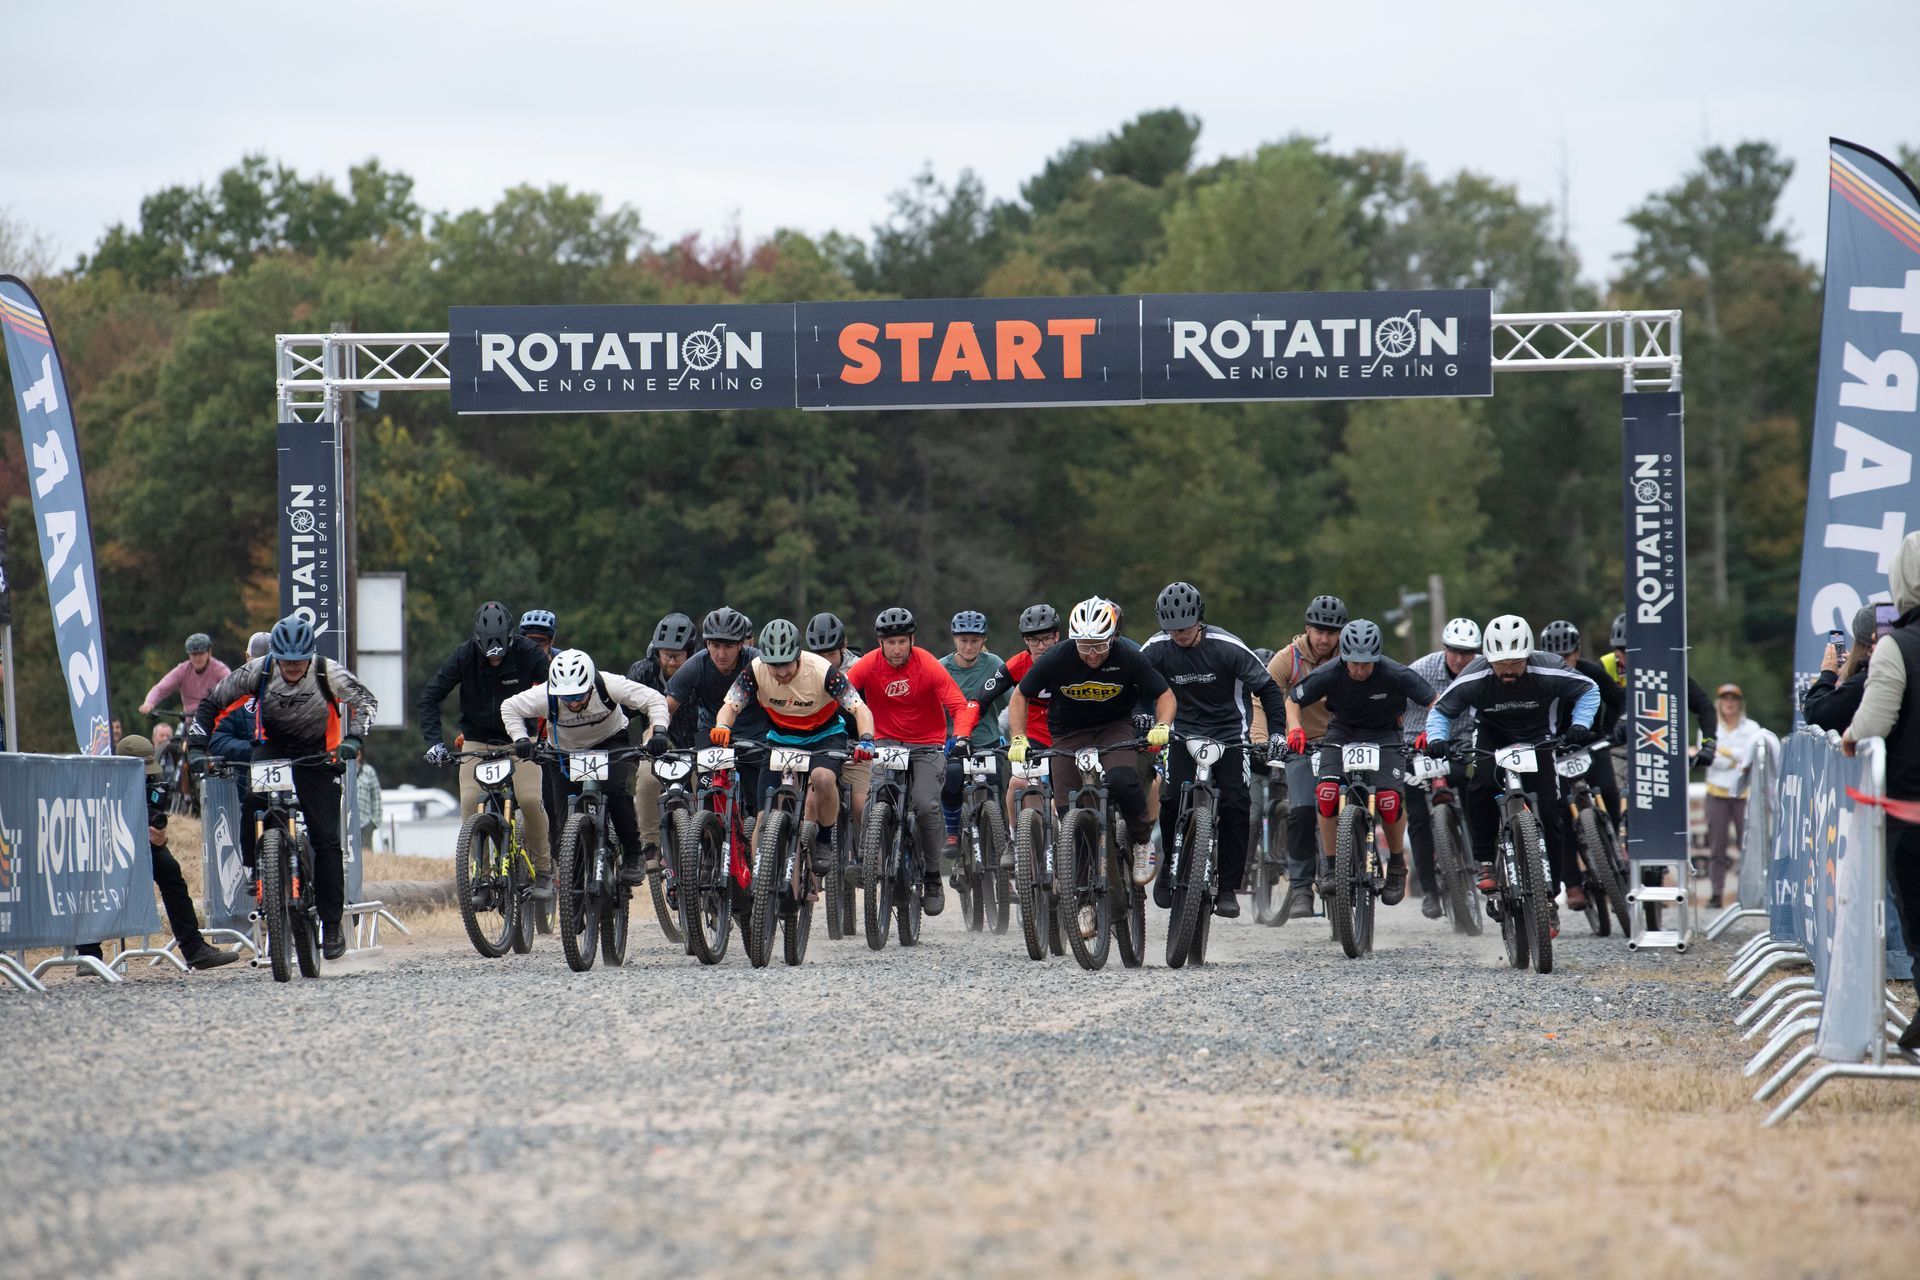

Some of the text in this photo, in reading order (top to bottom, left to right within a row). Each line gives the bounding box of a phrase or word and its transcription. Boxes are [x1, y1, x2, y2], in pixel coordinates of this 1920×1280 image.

[481, 324, 762, 392] ROTATION
[838, 318, 1097, 385] START
[1173, 310, 1458, 380] ROTATION
[538, 376, 763, 392] ENGINEERING
[1229, 363, 1458, 380] ENGINEERING
[1630, 454, 1674, 623] ROTATION
[1664, 454, 1674, 589] ENGINEERING
[286, 485, 328, 638] OTATION
[318, 484, 329, 618] ENGINEERING
[1635, 690, 1669, 754] XC
[1670, 694, 1678, 756] CHAMPIONSHIP
[485, 765, 501, 781] 51
[582, 756, 597, 773] 14
[707, 748, 724, 763] 32
[883, 748, 900, 762] 37
[1082, 754, 1091, 770] 3
[1199, 744, 1209, 760] 6
[1348, 748, 1373, 765] 281
[1511, 749, 1521, 765] 5
[1566, 758, 1584, 775] 66
[263, 766, 281, 784] 15
[1636, 753, 1653, 810] RACE
[1653, 755, 1670, 798] DAY
[38, 787, 136, 916] ROTATION
[1170, 833, 1184, 876] 36 FOX
[1505, 842, 1518, 886] 36 FOX
